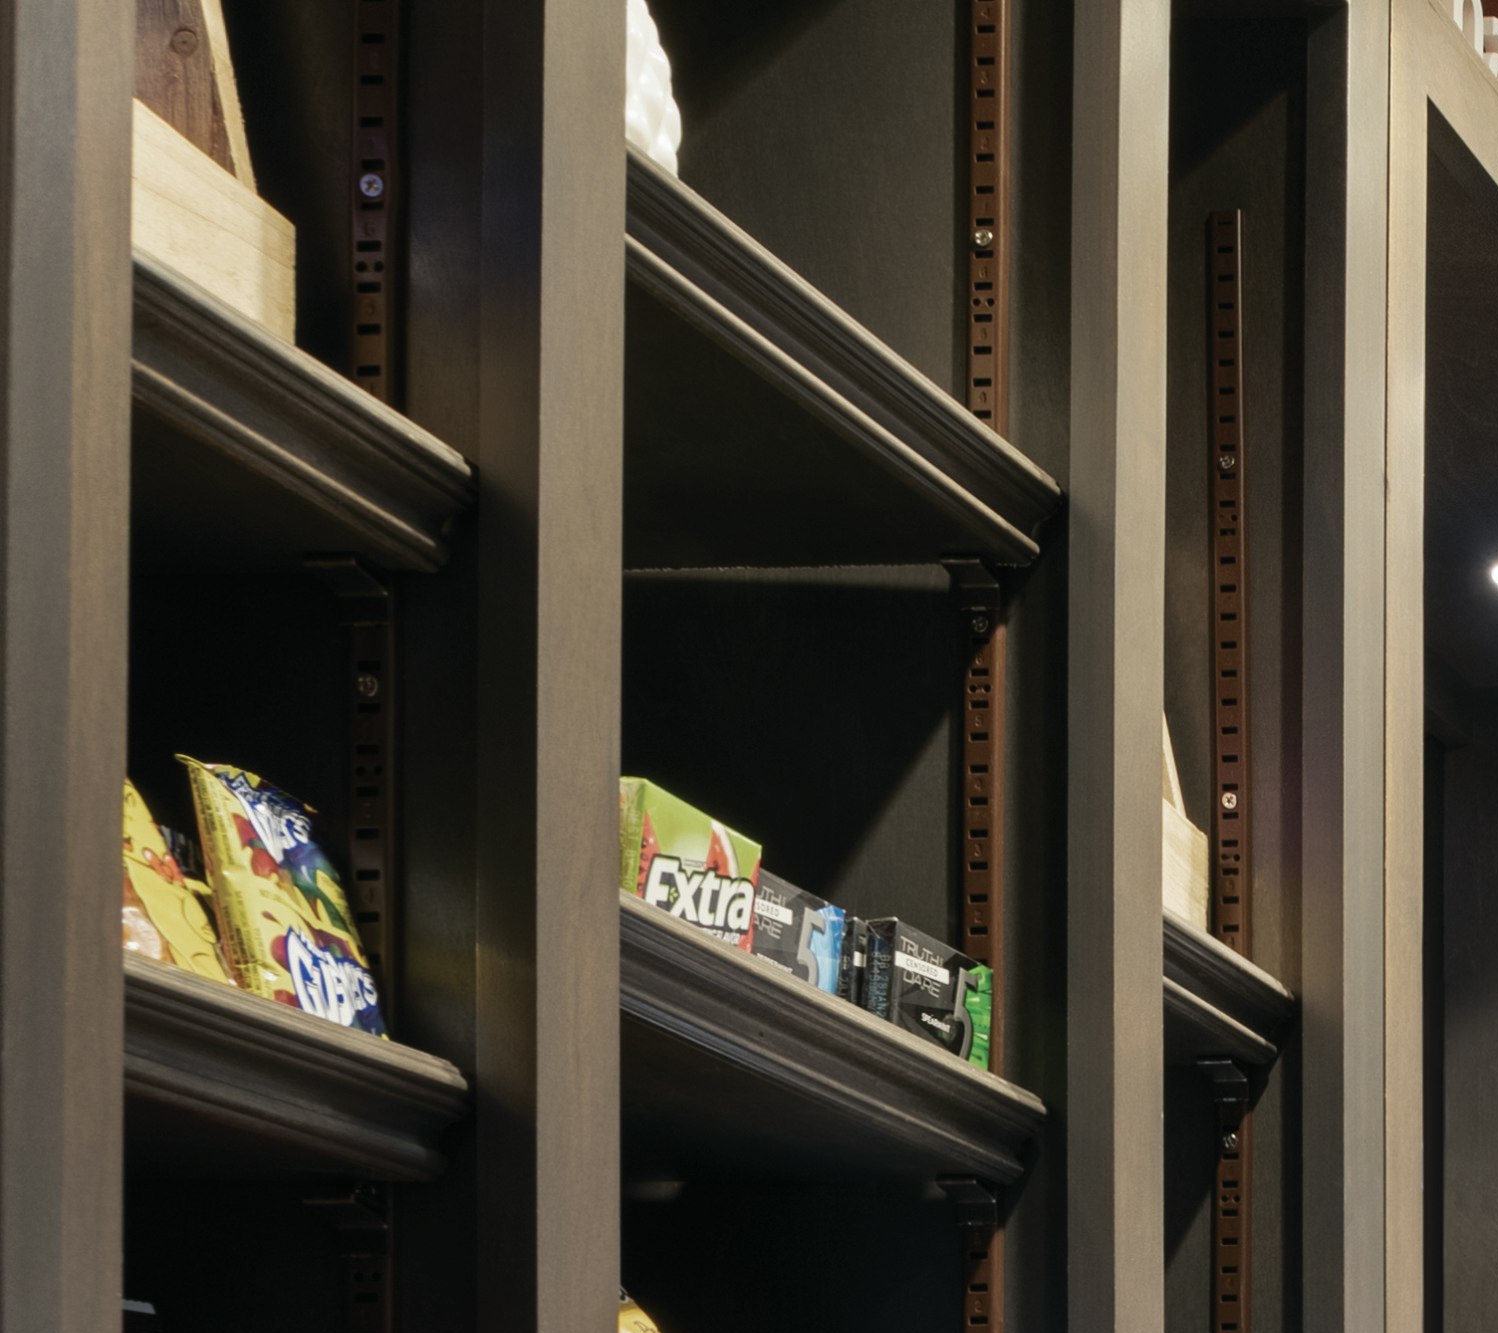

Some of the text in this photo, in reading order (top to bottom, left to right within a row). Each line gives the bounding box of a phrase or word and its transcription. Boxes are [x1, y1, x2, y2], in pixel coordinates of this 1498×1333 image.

[644, 854, 756, 931] Extra
[905, 956, 940, 977] CENSORED
[903, 969, 943, 999] DARE
